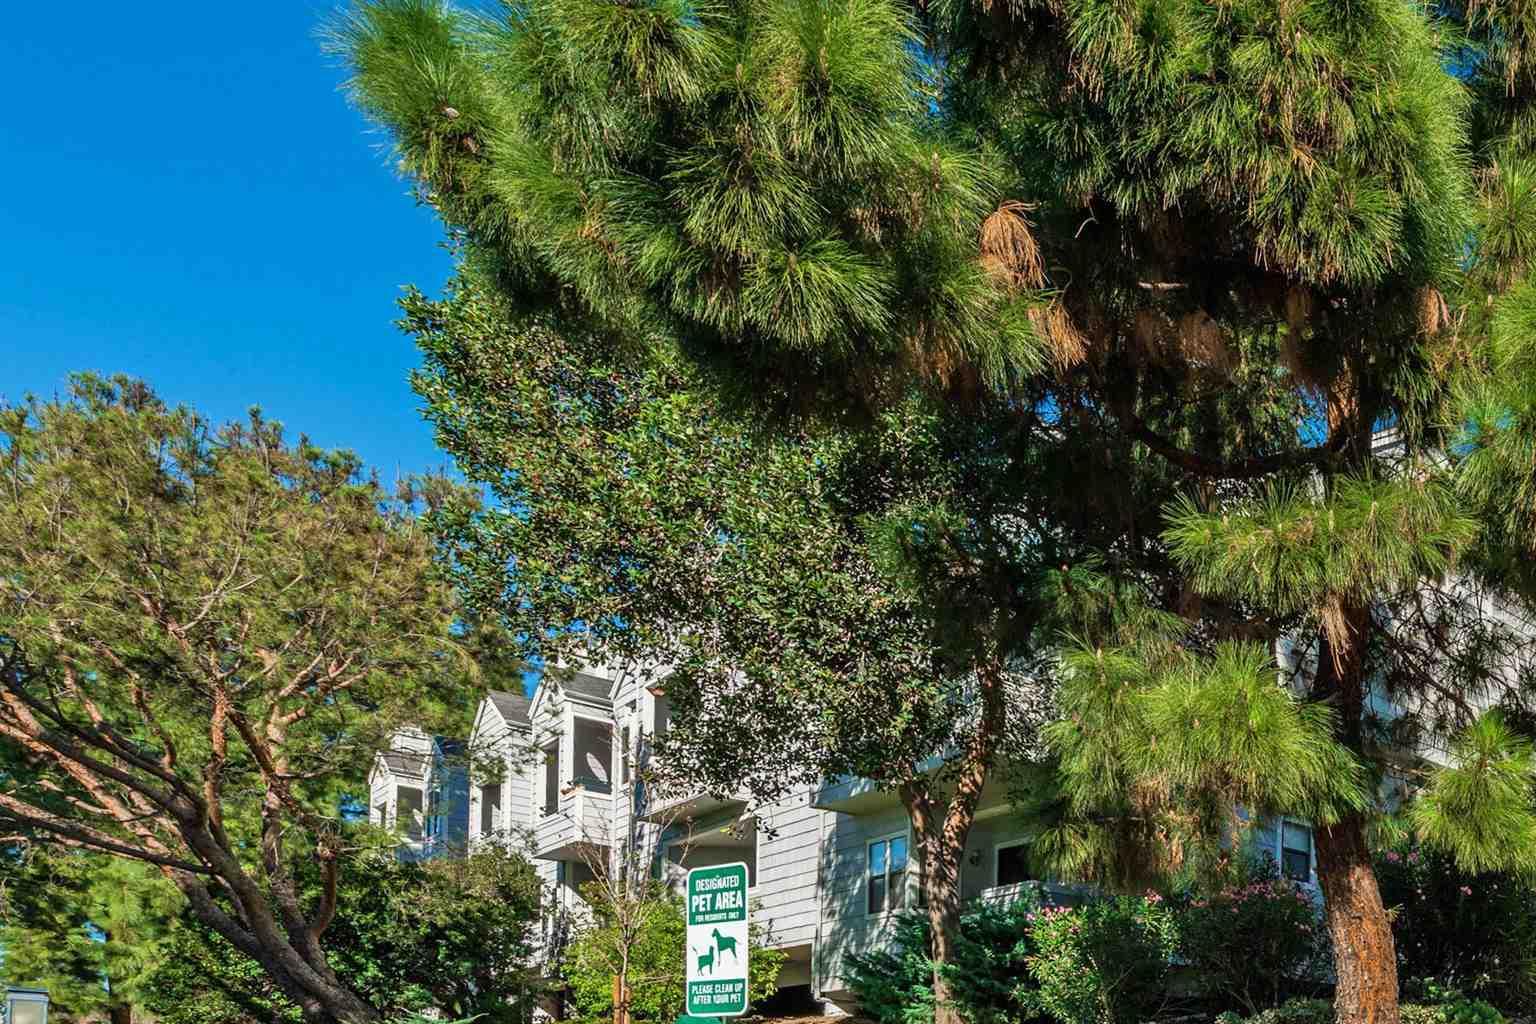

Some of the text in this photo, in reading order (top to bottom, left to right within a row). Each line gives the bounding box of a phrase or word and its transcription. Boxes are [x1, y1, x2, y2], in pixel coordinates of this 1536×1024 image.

[695, 875, 739, 891] DESIGNATED
[692, 890, 743, 912] PET AREA
[695, 914, 704, 923] FOR
[728, 911, 739, 920] ONLY
[691, 983, 743, 994] PLEASE CLEAN UP
[693, 993, 741, 1004] AFTER YOUR PET
